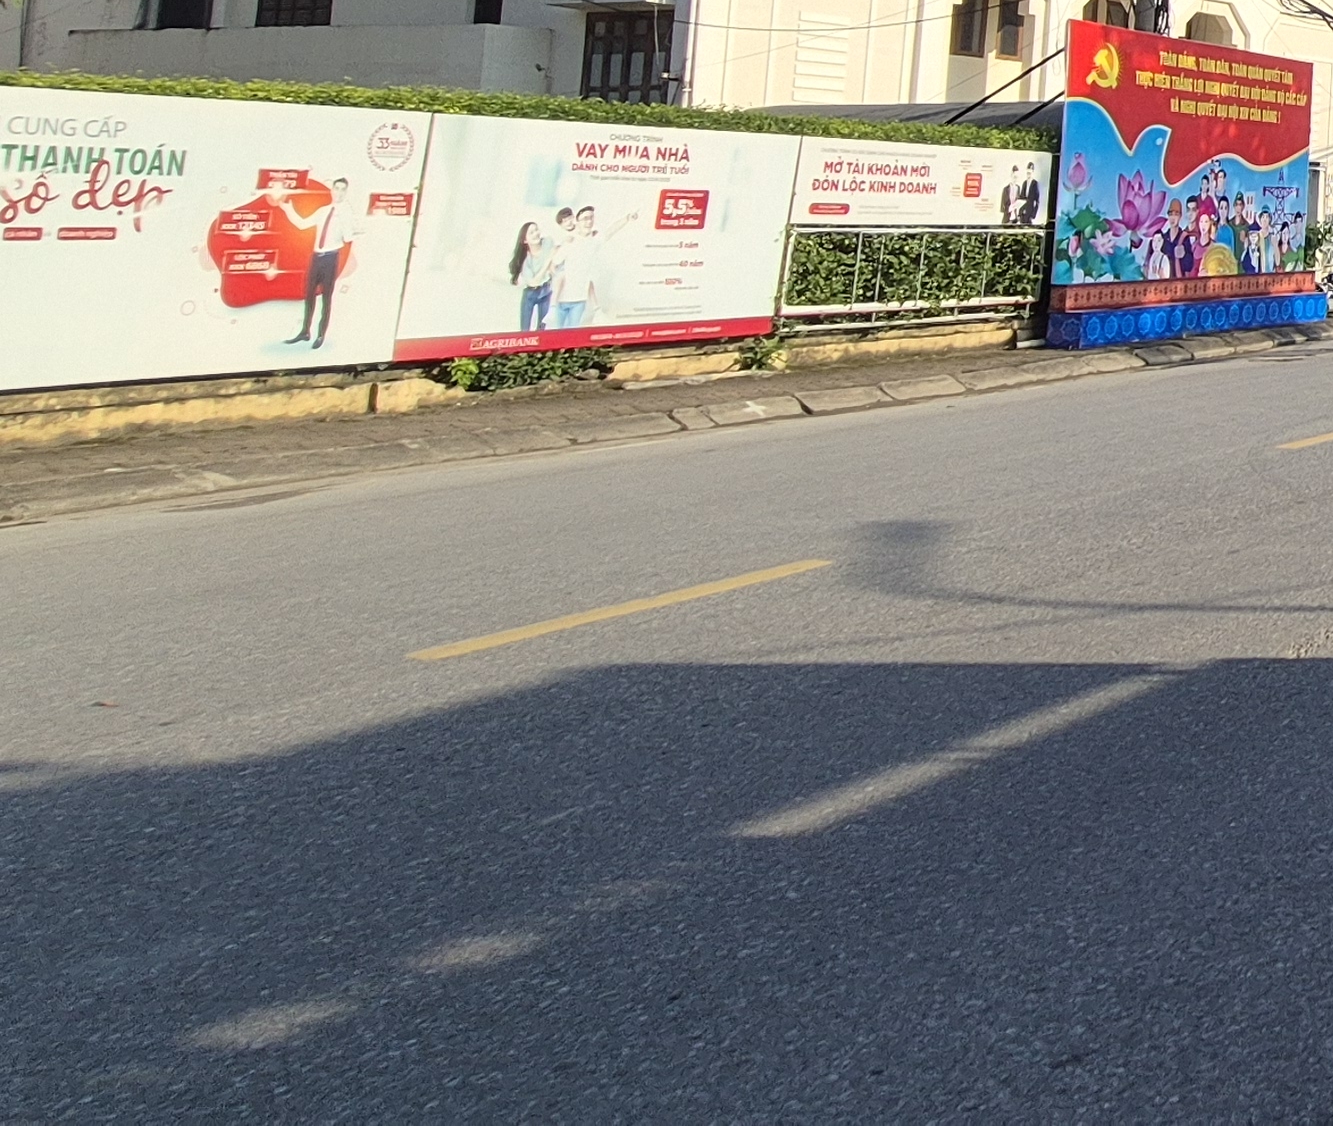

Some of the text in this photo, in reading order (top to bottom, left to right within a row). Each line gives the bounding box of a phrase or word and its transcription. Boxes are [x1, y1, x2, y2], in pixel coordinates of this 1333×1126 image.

[7, 114, 128, 139] CUNG CẤP
[1, 142, 188, 177] THANH TOÁN
[575, 142, 690, 162] VAY MUA NHÀ
[600, 164, 620, 173] CHO
[823, 155, 931, 178] MỞ TÀI KHOẢN MỚI
[72, 159, 174, 233] đẹp
[842, 176, 866, 197] LỘC
[868, 179, 897, 193] KINH
[899, 180, 938, 195] DOANH
[482, 336, 539, 349] AGRIBANK
